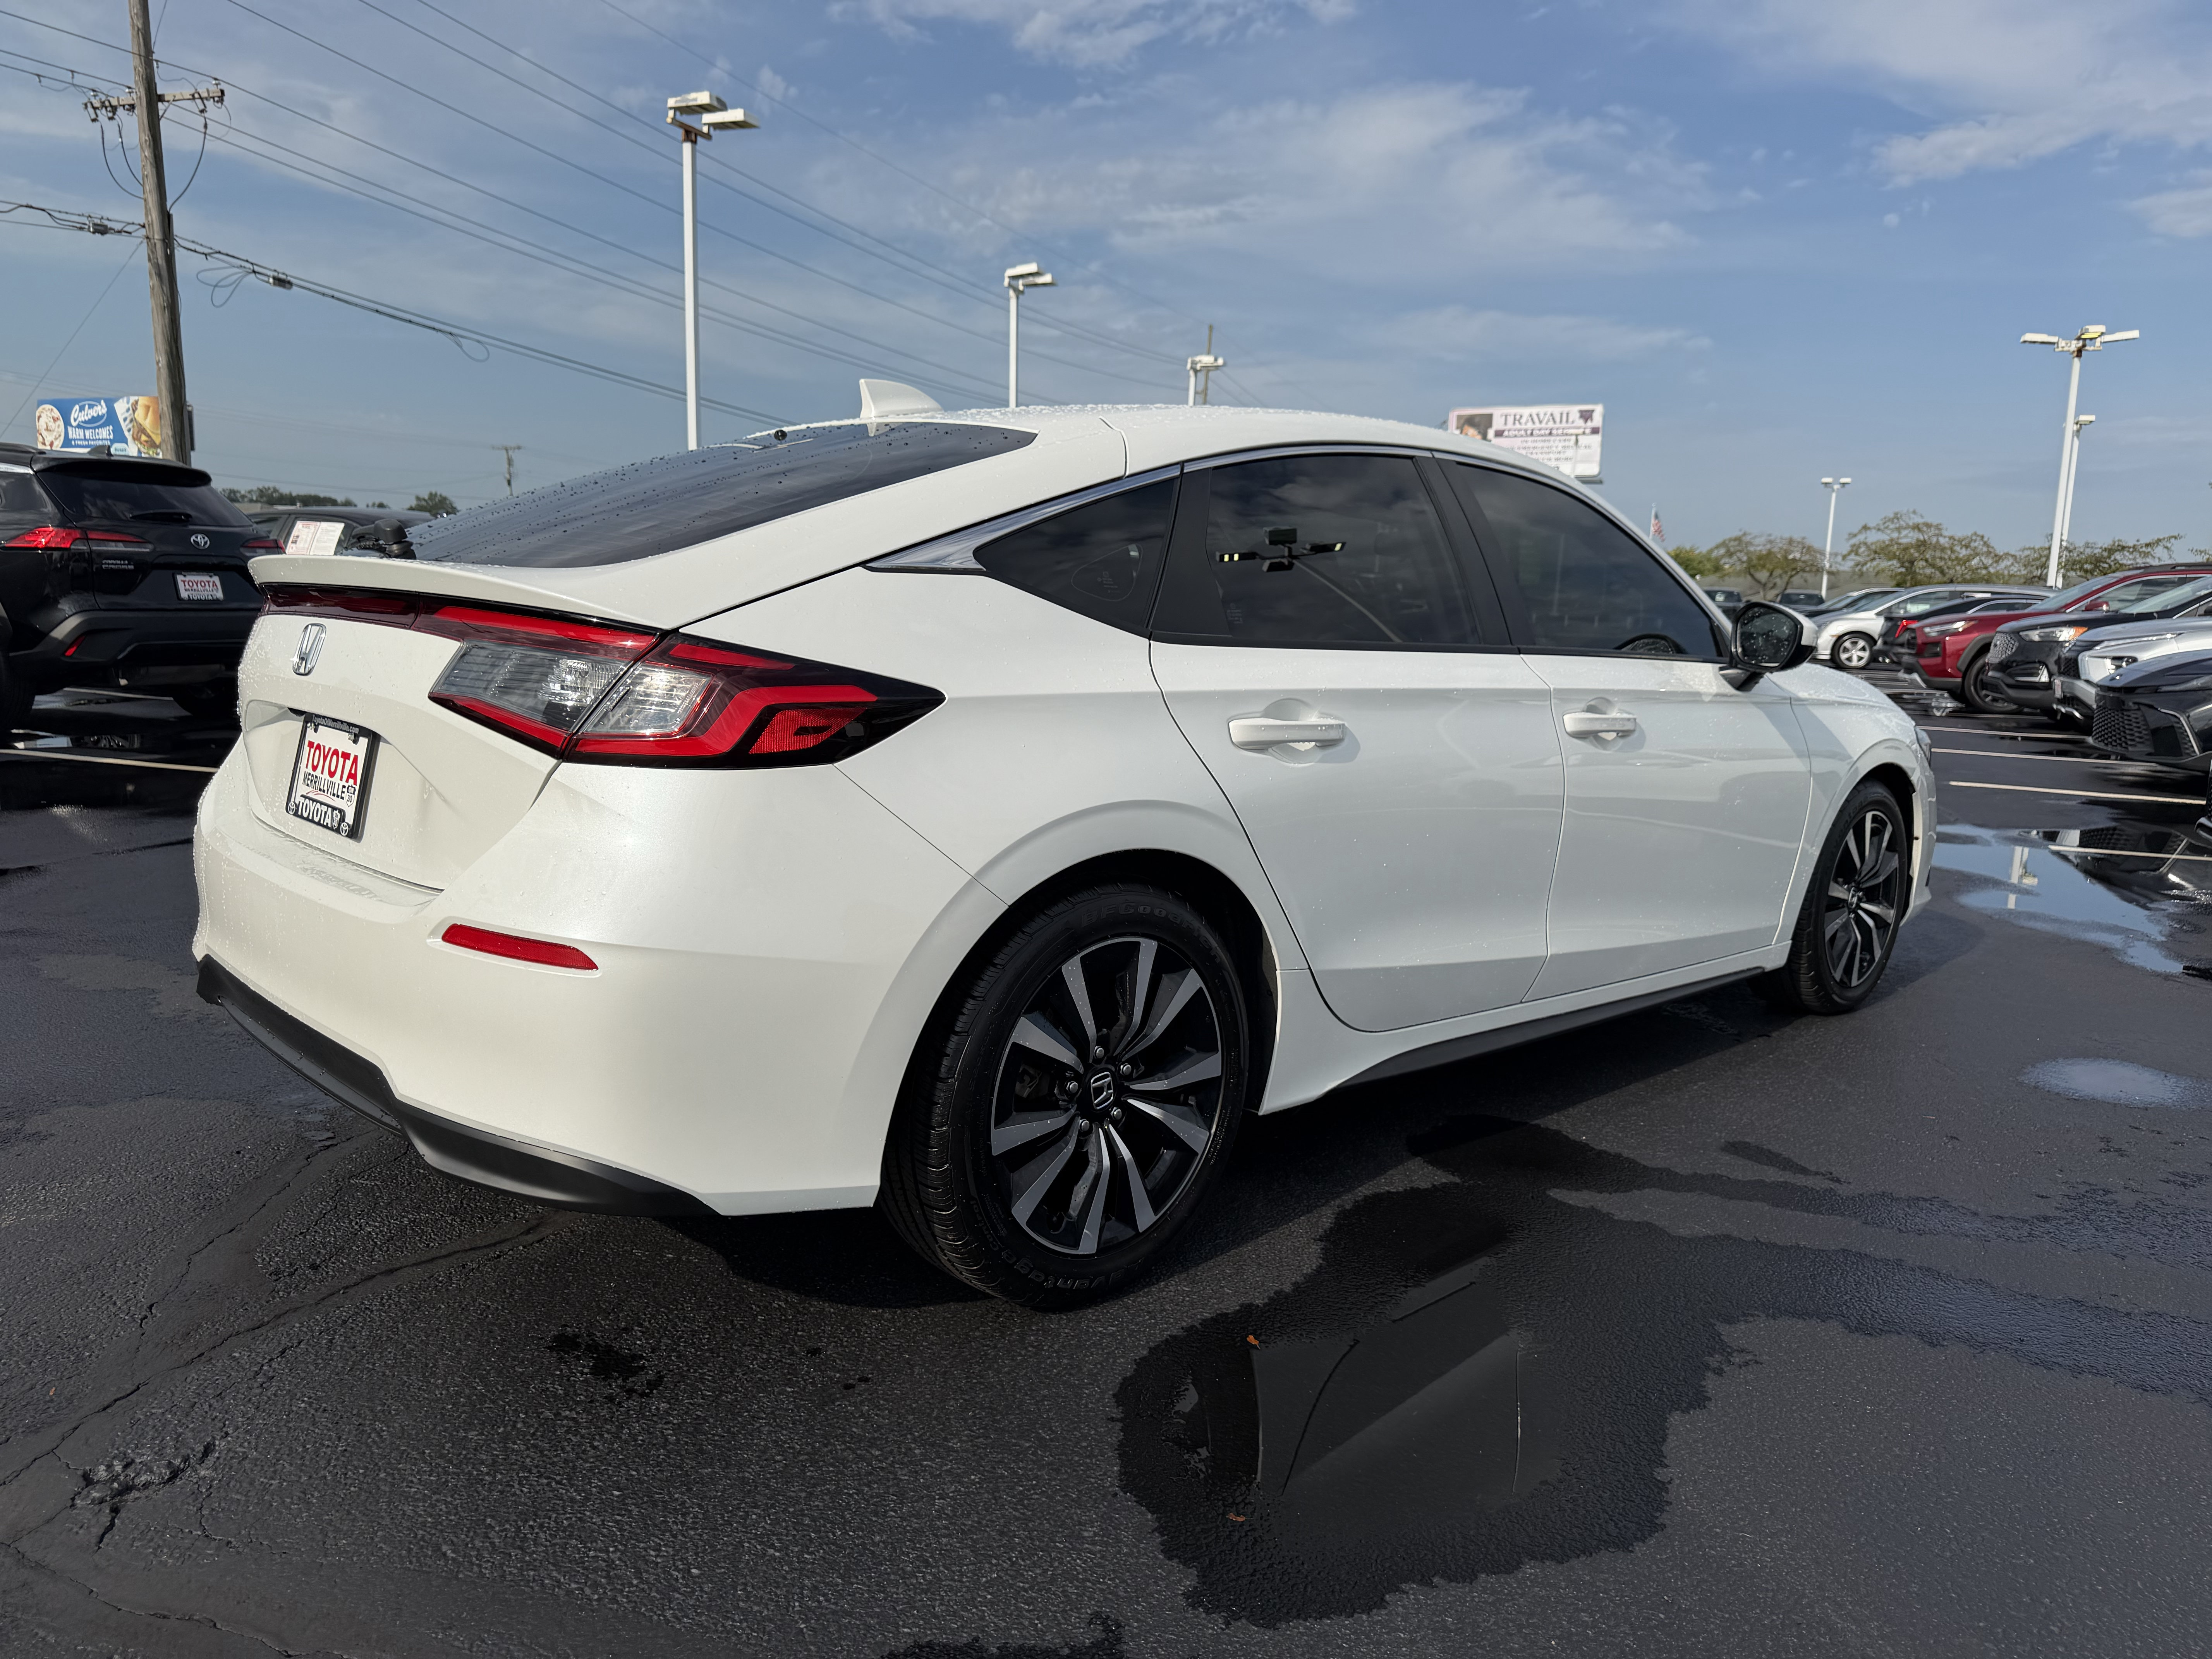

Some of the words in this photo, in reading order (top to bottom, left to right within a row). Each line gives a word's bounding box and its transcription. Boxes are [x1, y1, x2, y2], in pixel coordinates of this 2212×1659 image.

[1500, 410, 1576, 426] TRAVAIL
[67, 426, 84, 440] WARM
[84, 425, 113, 440] WELCOMES
[180, 579, 218, 589] TOYOTA
[306, 740, 358, 786] TOYOTA
[302, 770, 346, 800] MERRILLVILLE
[298, 797, 331, 827] TOYOTA
